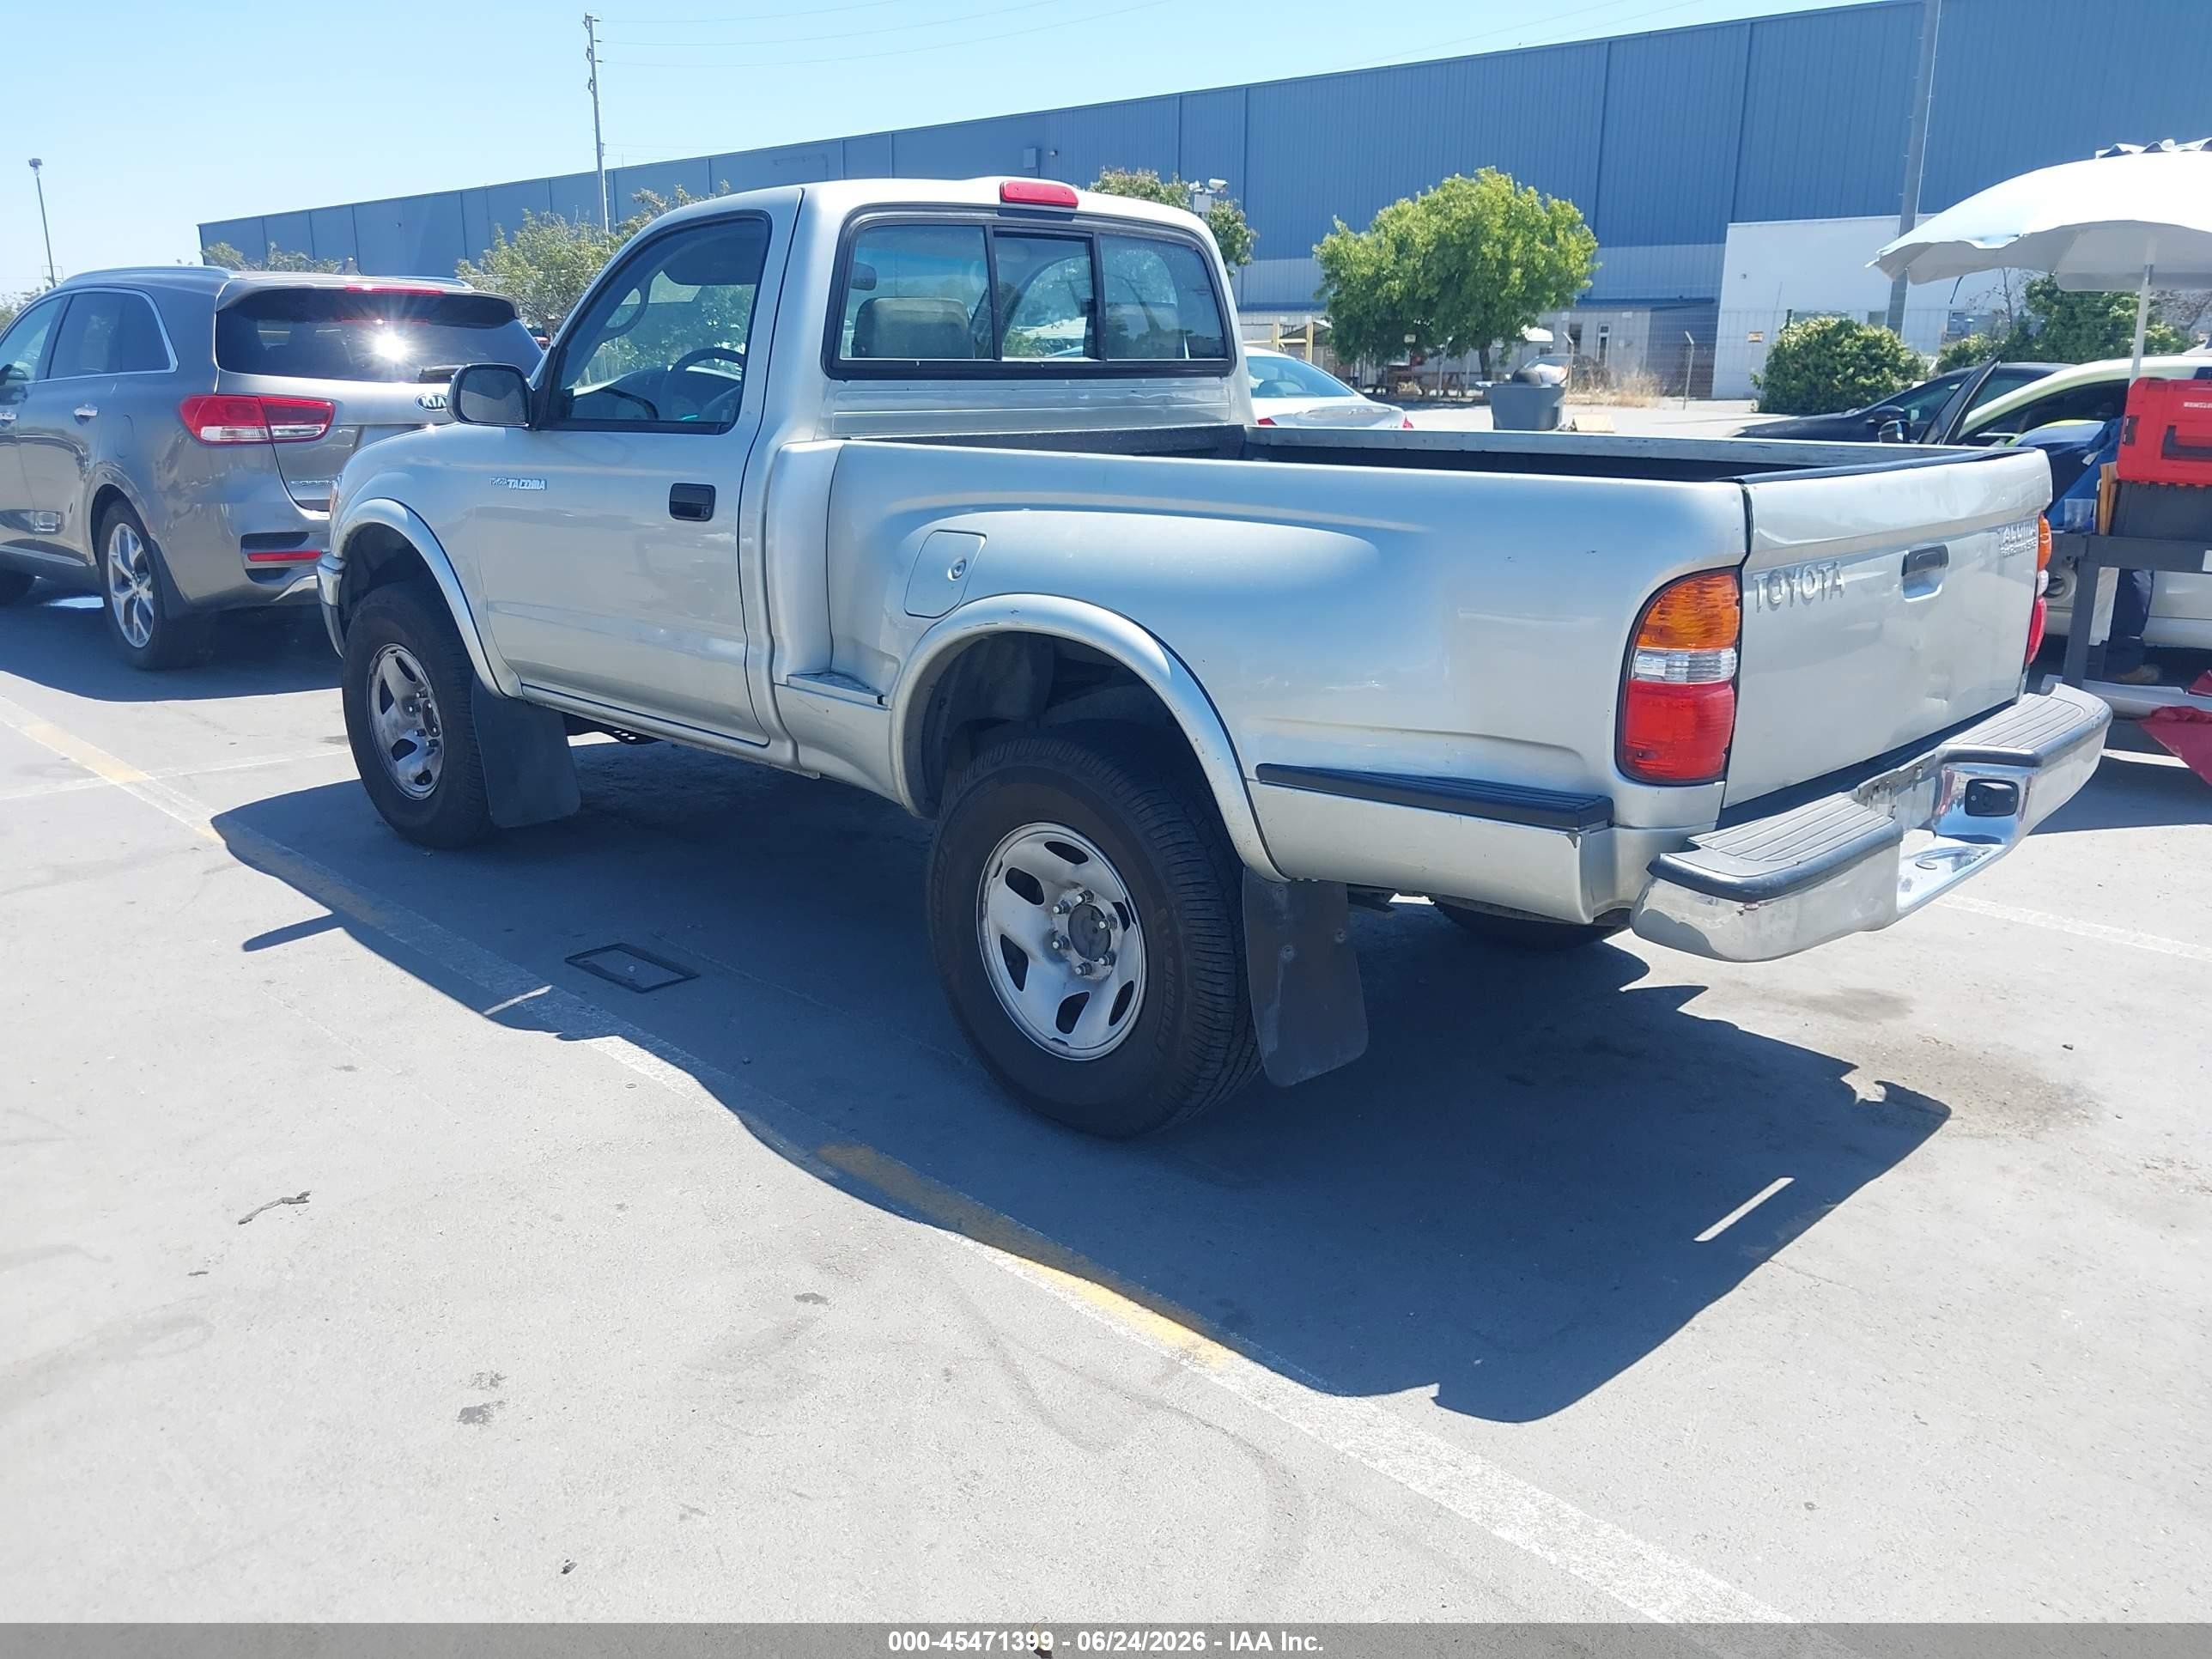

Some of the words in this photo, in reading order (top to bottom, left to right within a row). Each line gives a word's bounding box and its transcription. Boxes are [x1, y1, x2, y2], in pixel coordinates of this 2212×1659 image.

[421, 395, 447, 408] KIA
[507, 478, 547, 490] TACOMA
[1752, 561, 1845, 613] TOYOTA
